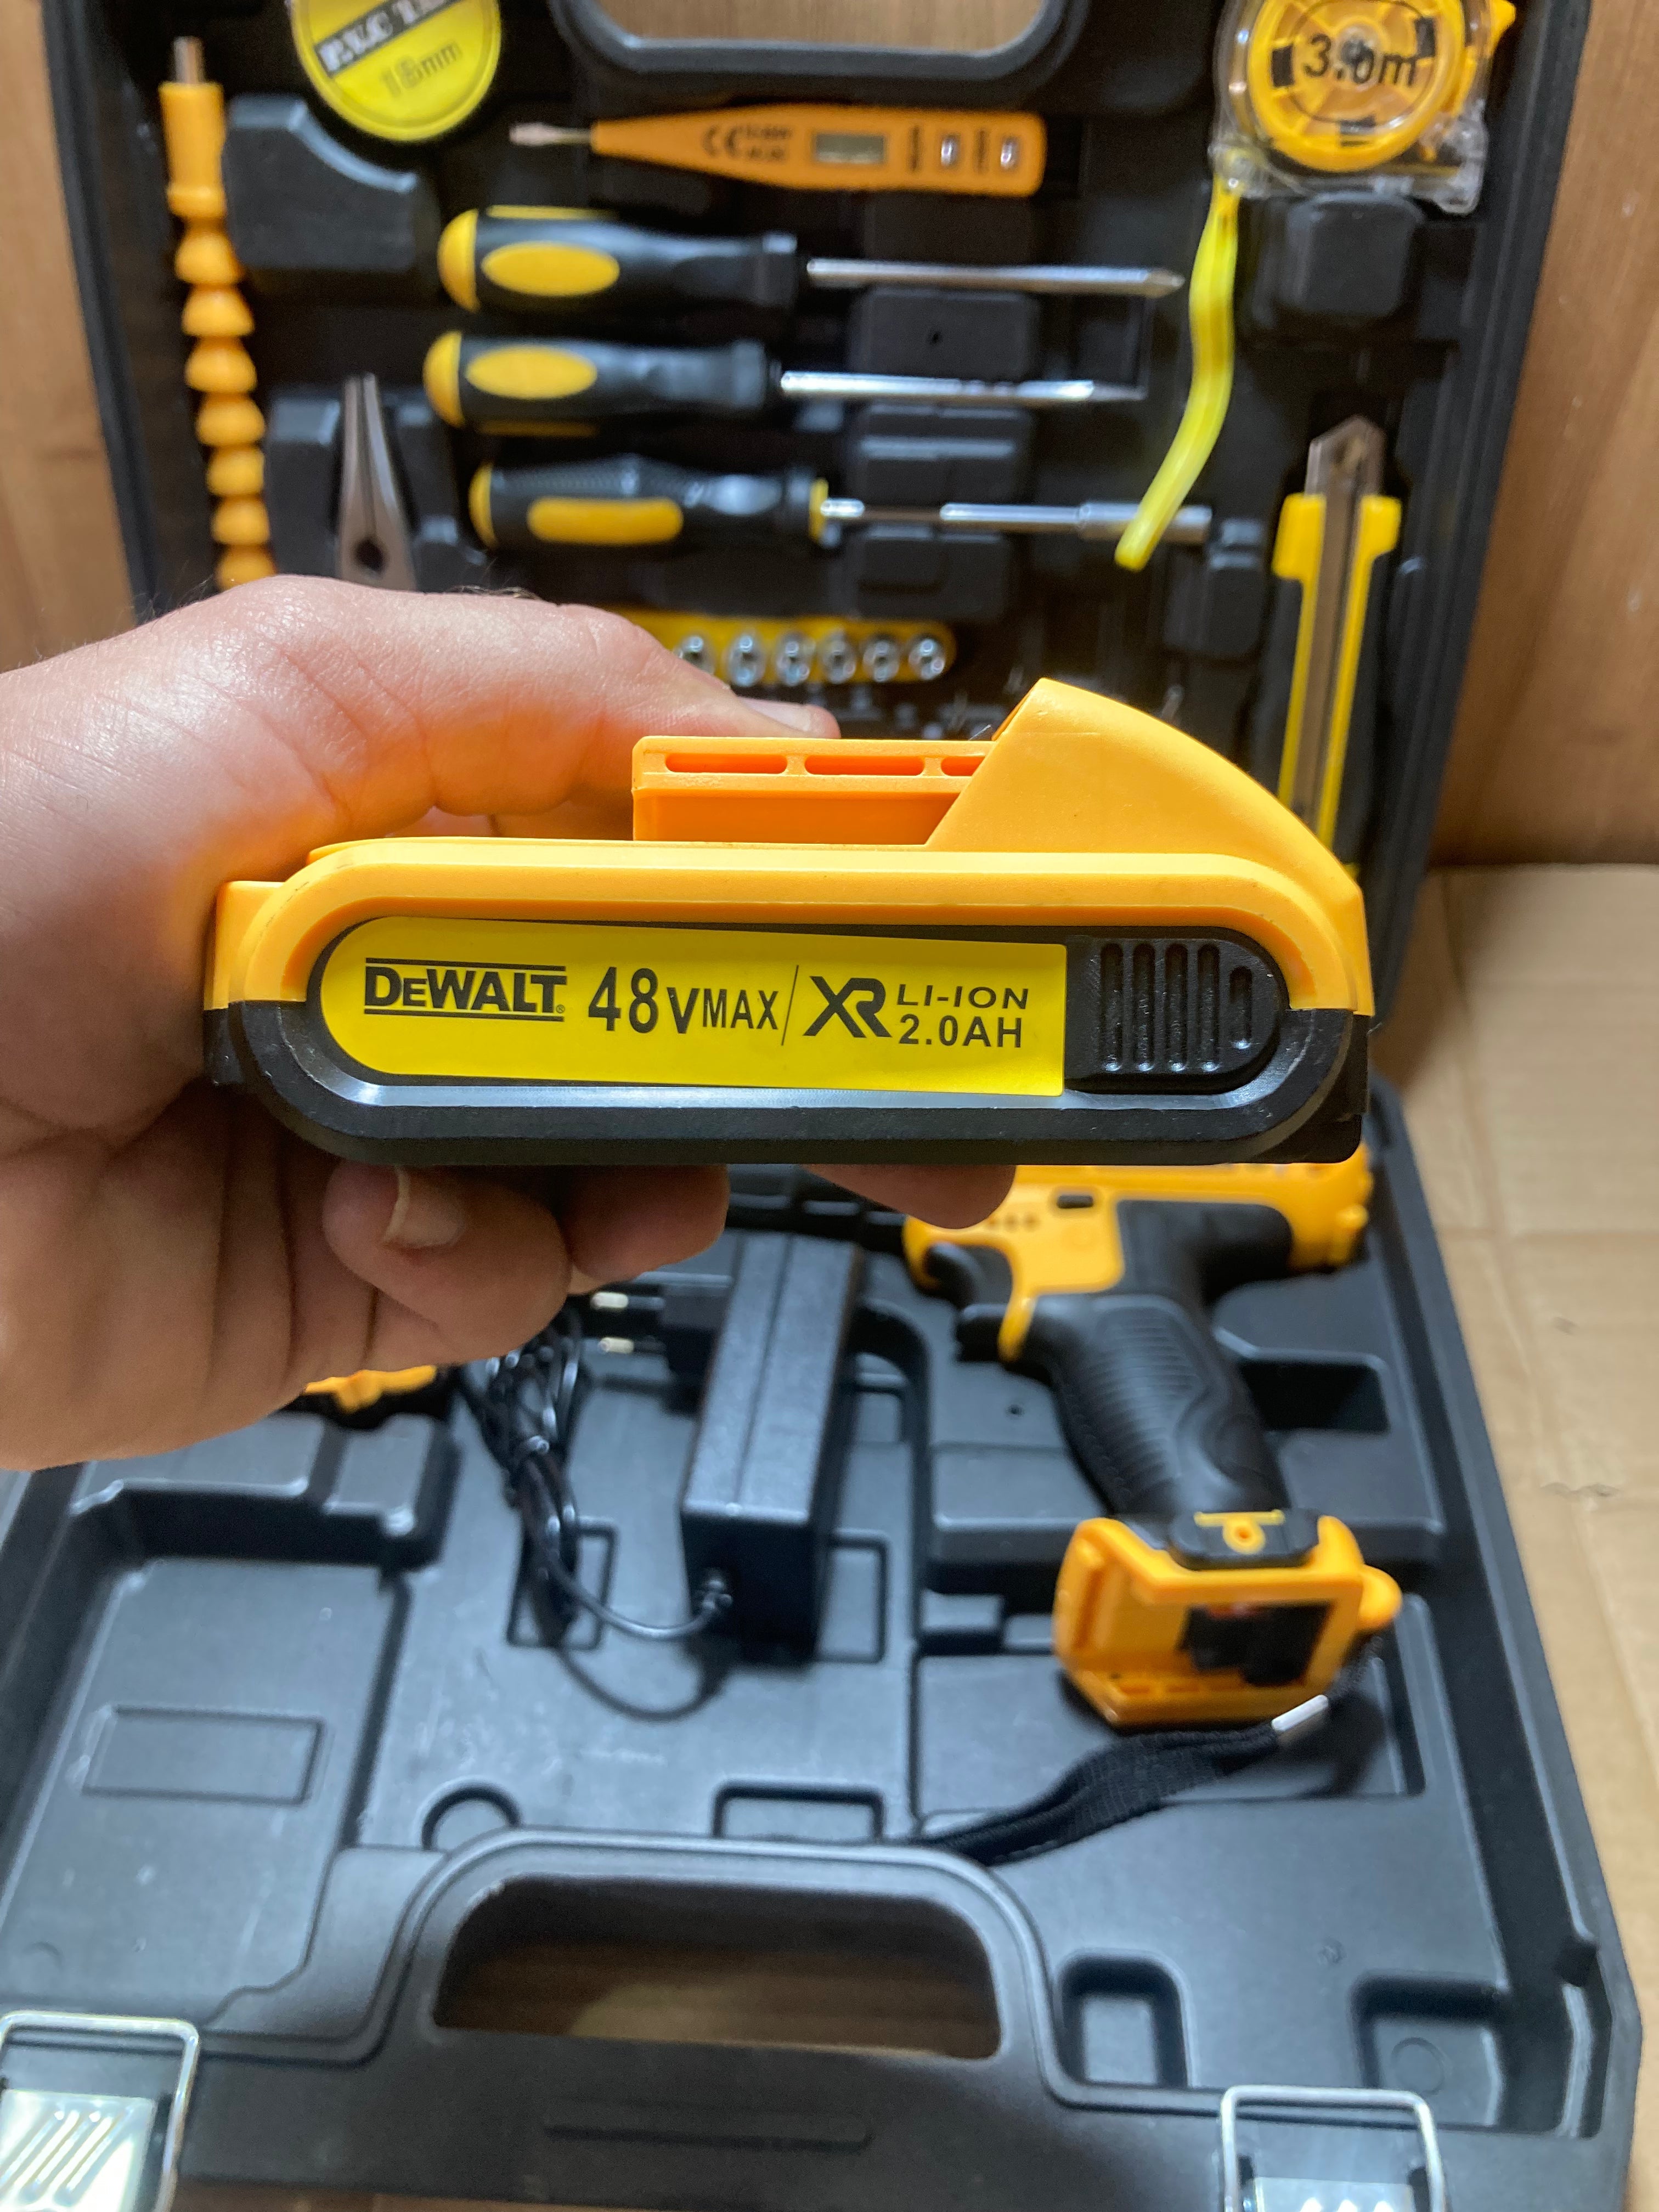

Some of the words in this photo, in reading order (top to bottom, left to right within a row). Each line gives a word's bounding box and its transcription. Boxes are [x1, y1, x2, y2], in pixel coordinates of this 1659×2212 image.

[802, 976, 893, 1039] XR
[896, 984, 1029, 1010] LI-ION
[898, 1013, 1022, 1048] 2.0AH
